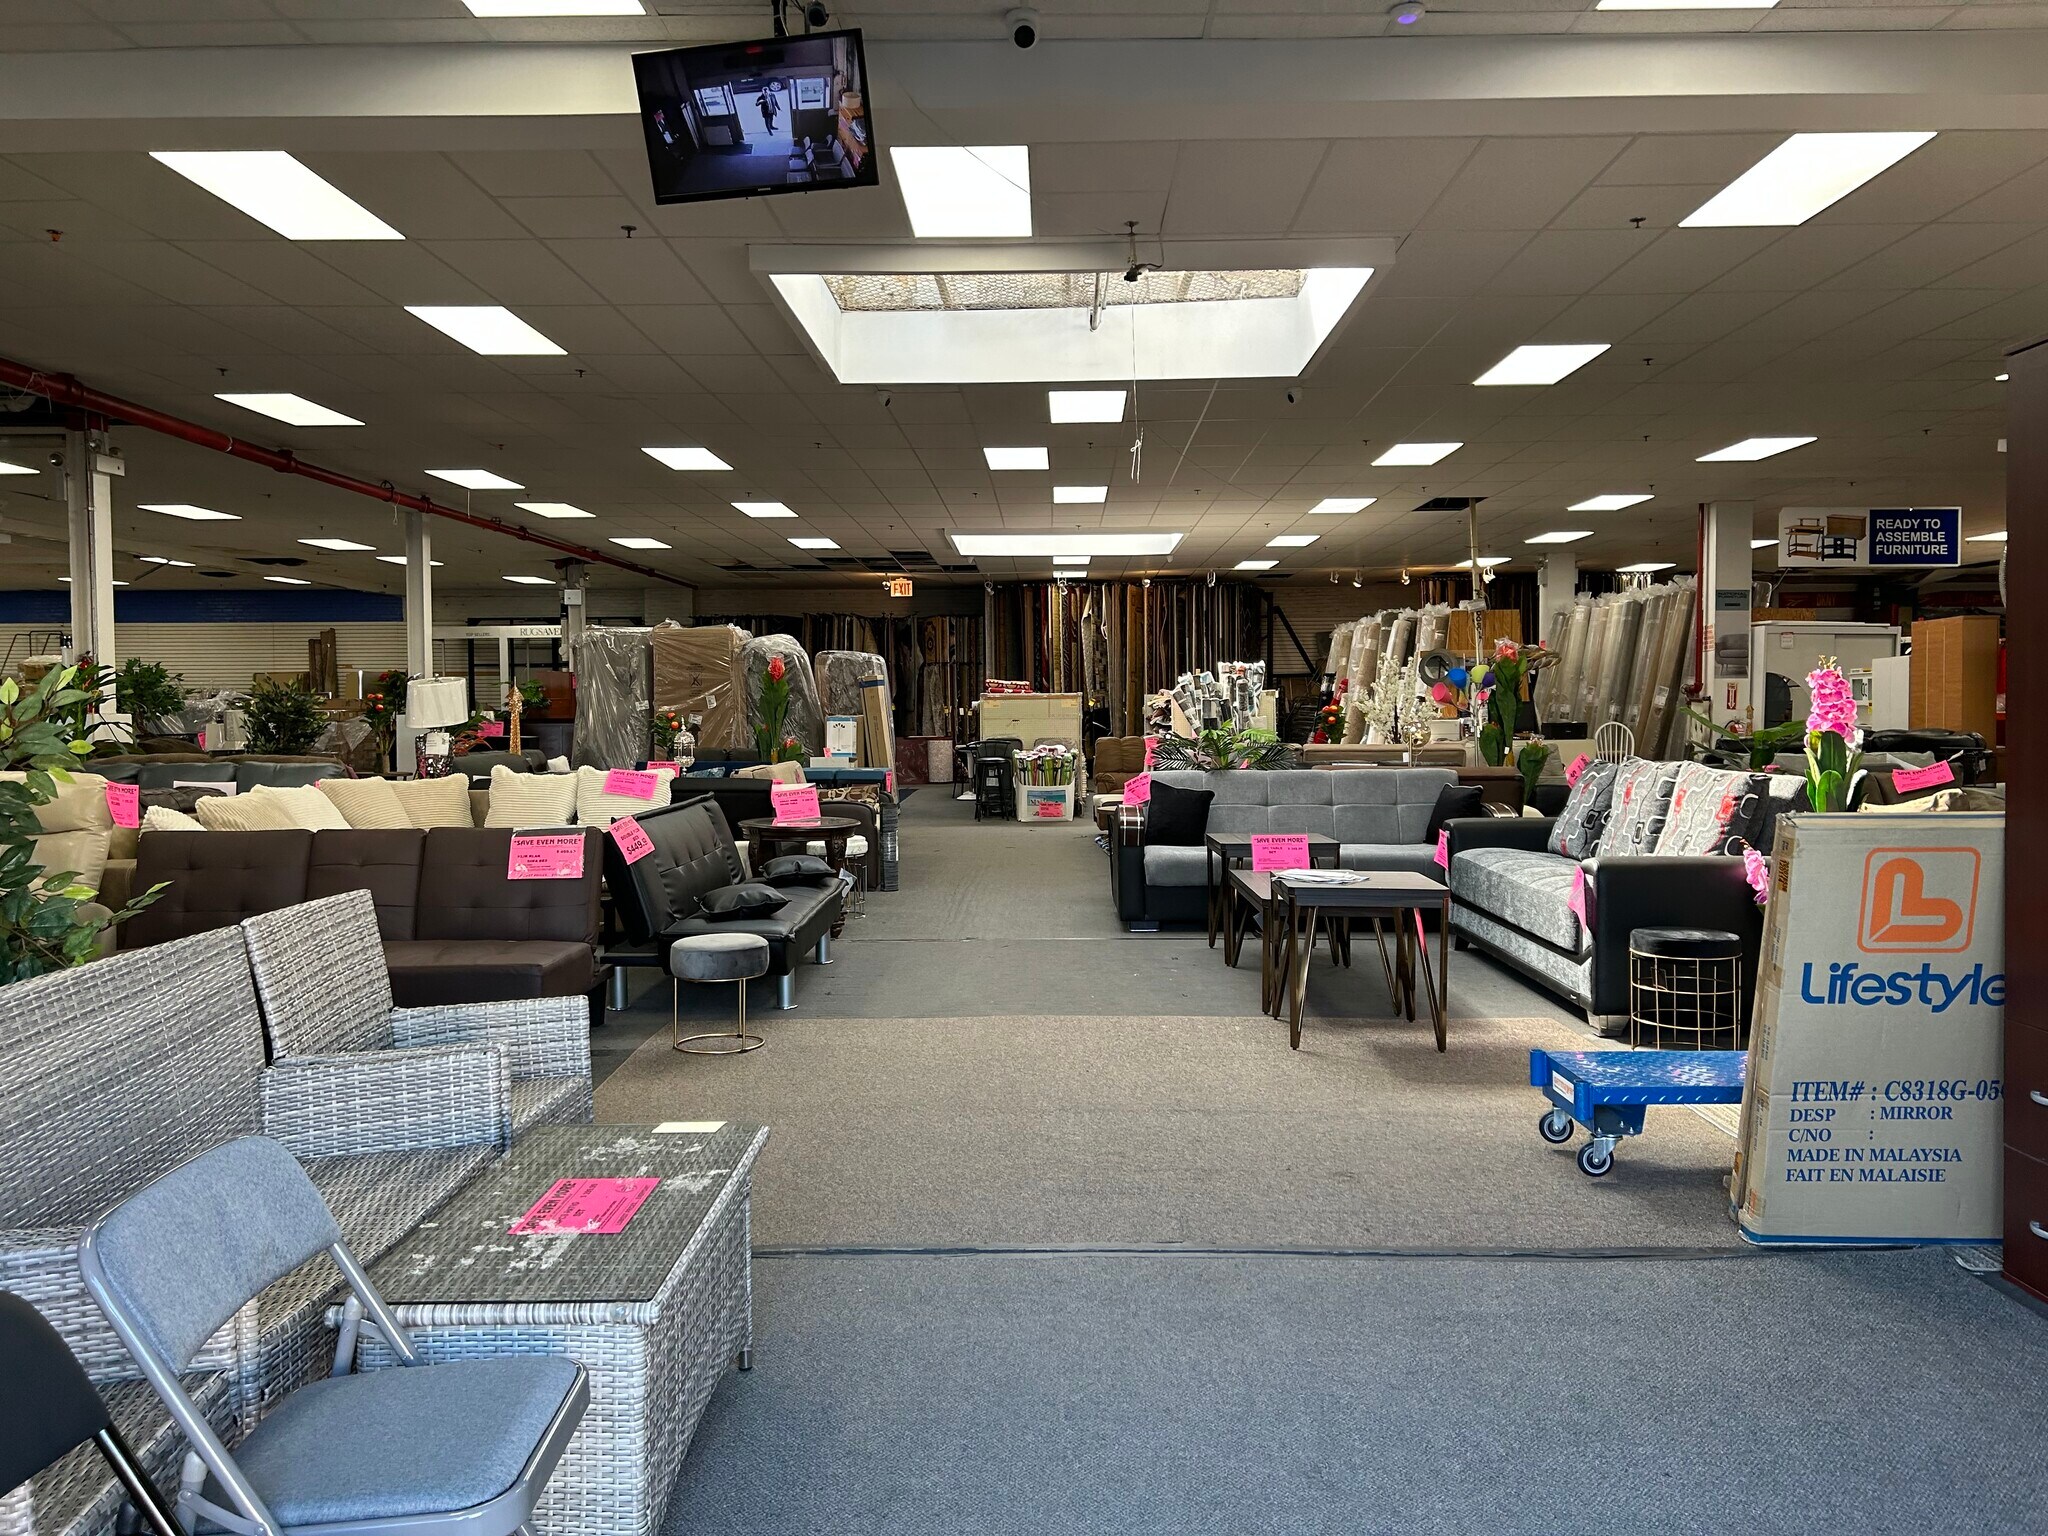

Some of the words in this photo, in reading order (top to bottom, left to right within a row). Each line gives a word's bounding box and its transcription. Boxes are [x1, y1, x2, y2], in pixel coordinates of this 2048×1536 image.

[1876, 519, 1921, 529] READY
[1923, 519, 1941, 529] TO
[1876, 532, 1946, 542] ASSEMBLE
[1876, 545, 1949, 555] FURNITURE
[893, 583, 911, 596] EXIT
[1801, 962, 2005, 1013] Lifestyle
[1790, 1080, 1866, 1102] ITEM#
[1884, 1079, 2004, 1102] C8318G-05
[1789, 1108, 1837, 1122] DESP
[1879, 1106, 1954, 1120] MIRROR
[1788, 1128, 1832, 1143] C/NO
[1787, 1148, 1840, 1162] MADE
[1844, 1148, 1866, 1162] IN
[1868, 1148, 1963, 1162] MALAYSIA
[1785, 1168, 1825, 1182] FAIT
[1829, 1168, 1855, 1182] EN
[1858, 1168, 1947, 1183] MALAISIE
